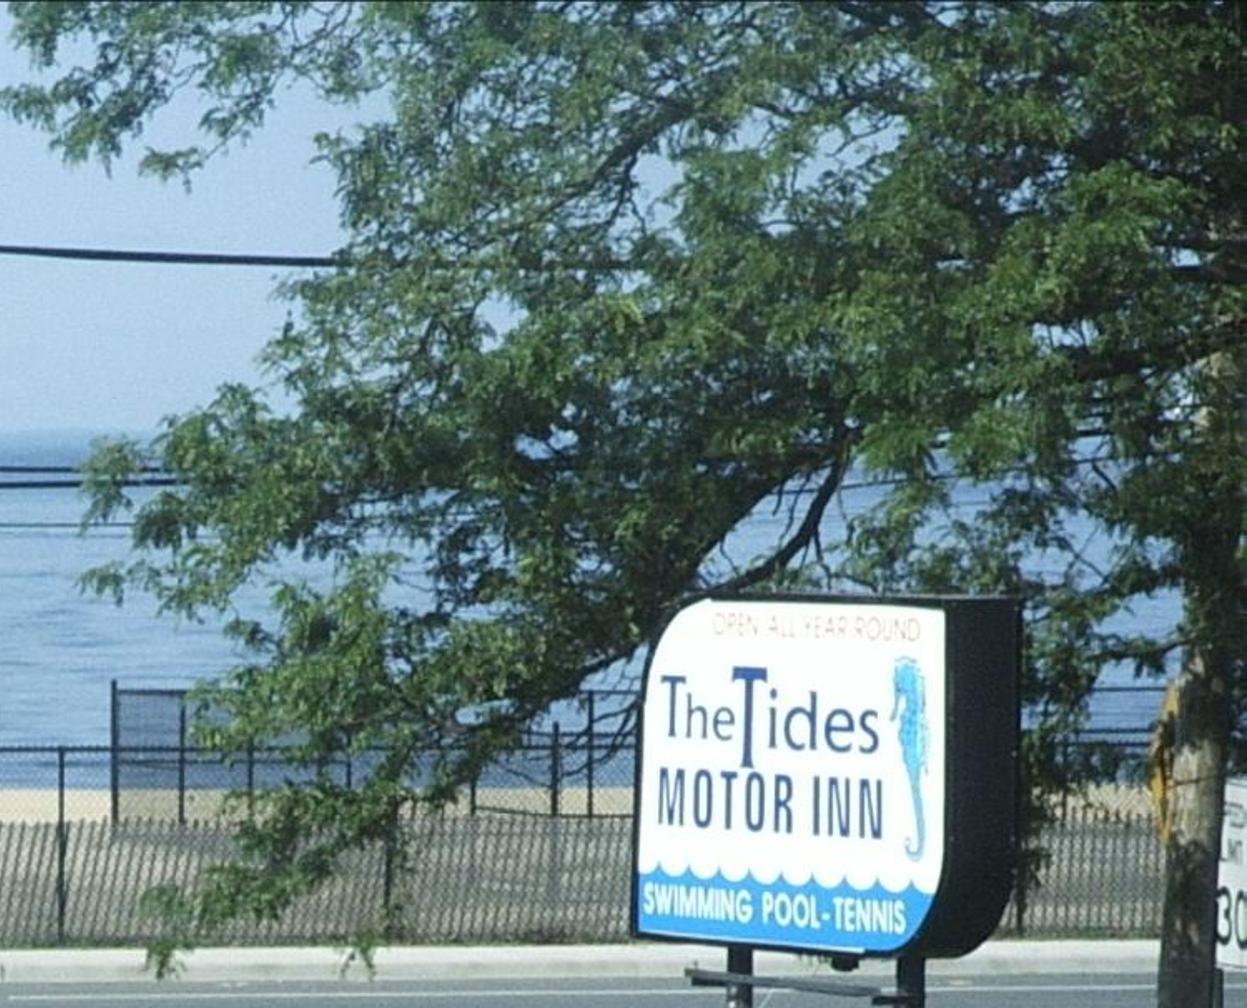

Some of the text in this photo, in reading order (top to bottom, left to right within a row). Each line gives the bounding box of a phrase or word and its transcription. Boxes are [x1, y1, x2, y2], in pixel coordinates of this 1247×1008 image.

[713, 612, 921, 642] OPEN ALL YEAR ROUND
[660, 665, 880, 768] The Tides
[658, 766, 883, 840] MOTOR INN
[643, 882, 753, 924] SWIMMING
